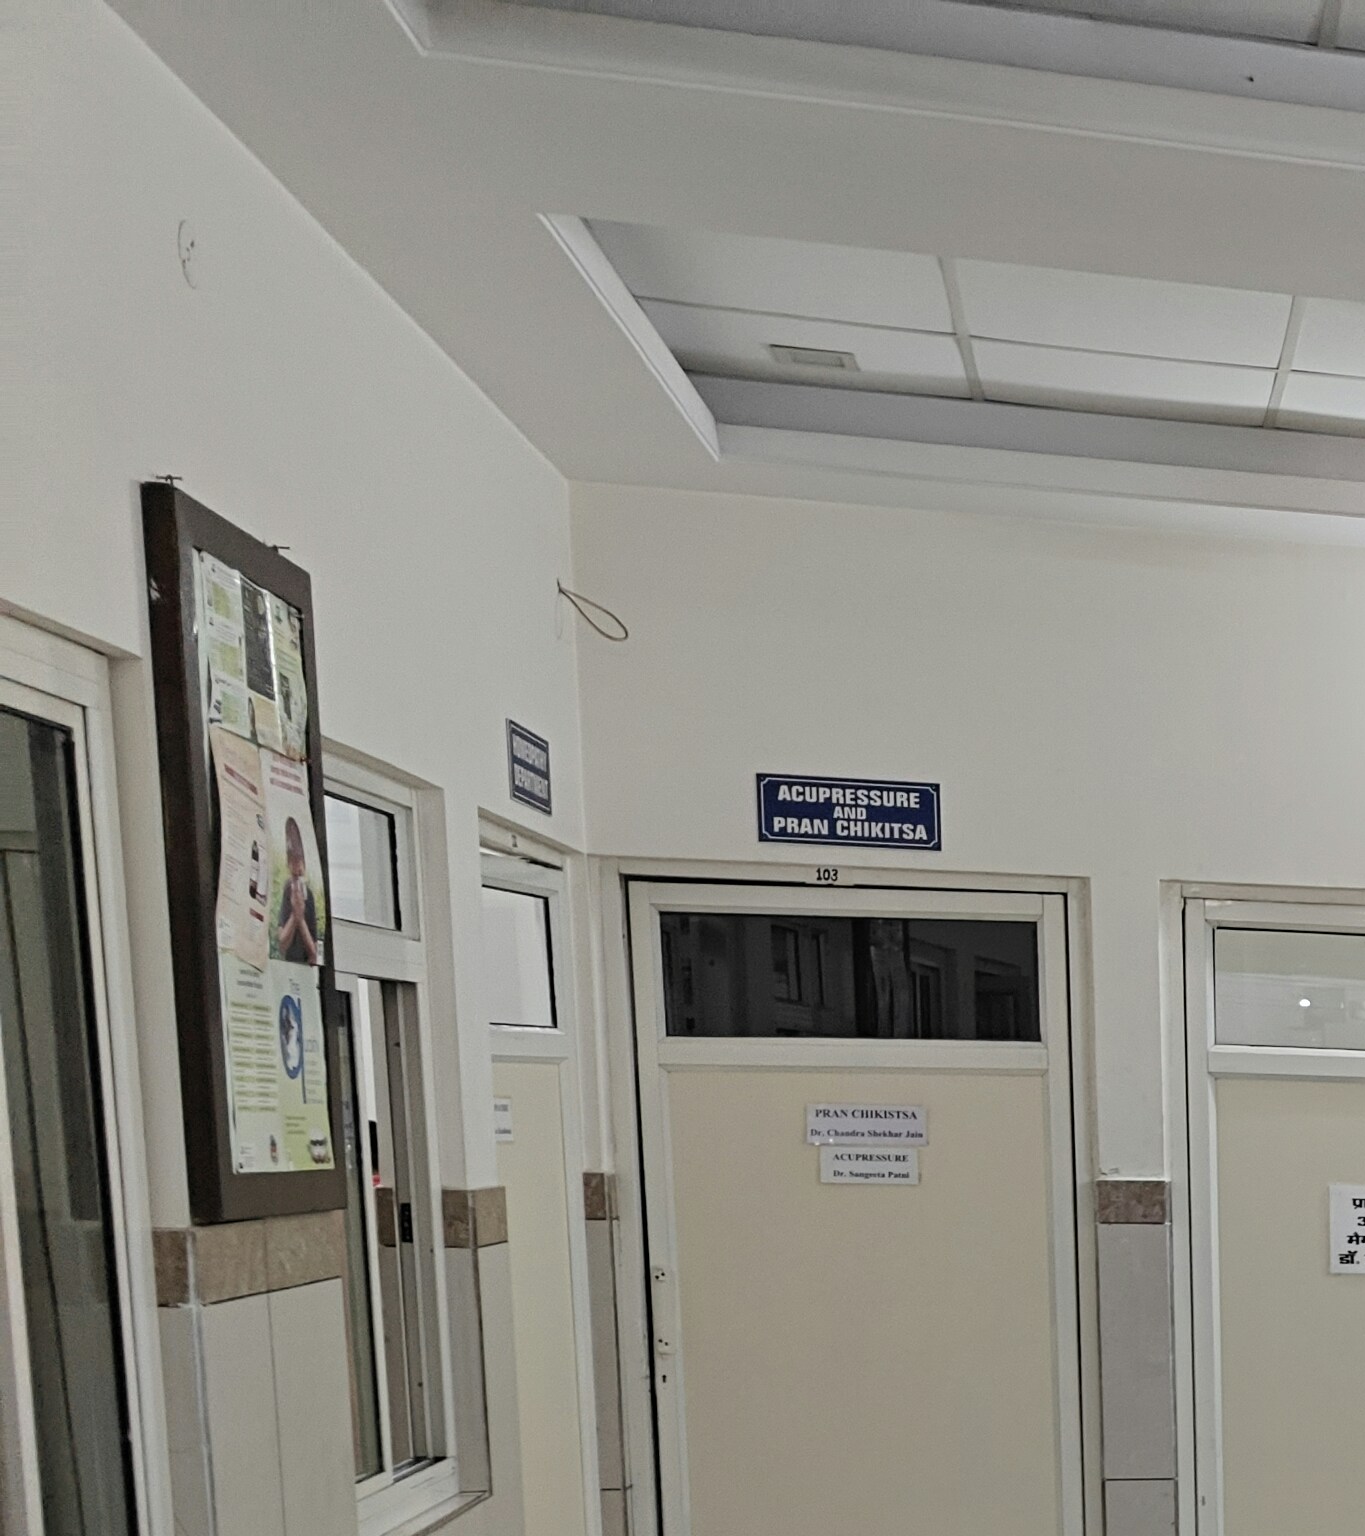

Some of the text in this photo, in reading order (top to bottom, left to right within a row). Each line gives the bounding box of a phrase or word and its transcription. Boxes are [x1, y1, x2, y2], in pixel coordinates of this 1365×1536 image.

[778, 785, 920, 809] ACUPRESSURE
[833, 806, 867, 820] AND
[773, 817, 928, 841] PRAN CHIKITSA
[816, 868, 838, 882] 103
[815, 1109, 918, 1120] PRAN CHIKISTSA
[810, 1128, 923, 1138] Dr. Chandra Shekhar Jain
[833, 1153, 909, 1163] ACUPRESSURE
[849, 1170, 885, 1179] Sangeeta
[888, 1171, 910, 1179] Patni
[1338, 1250, 1360, 1265] डॉ.
